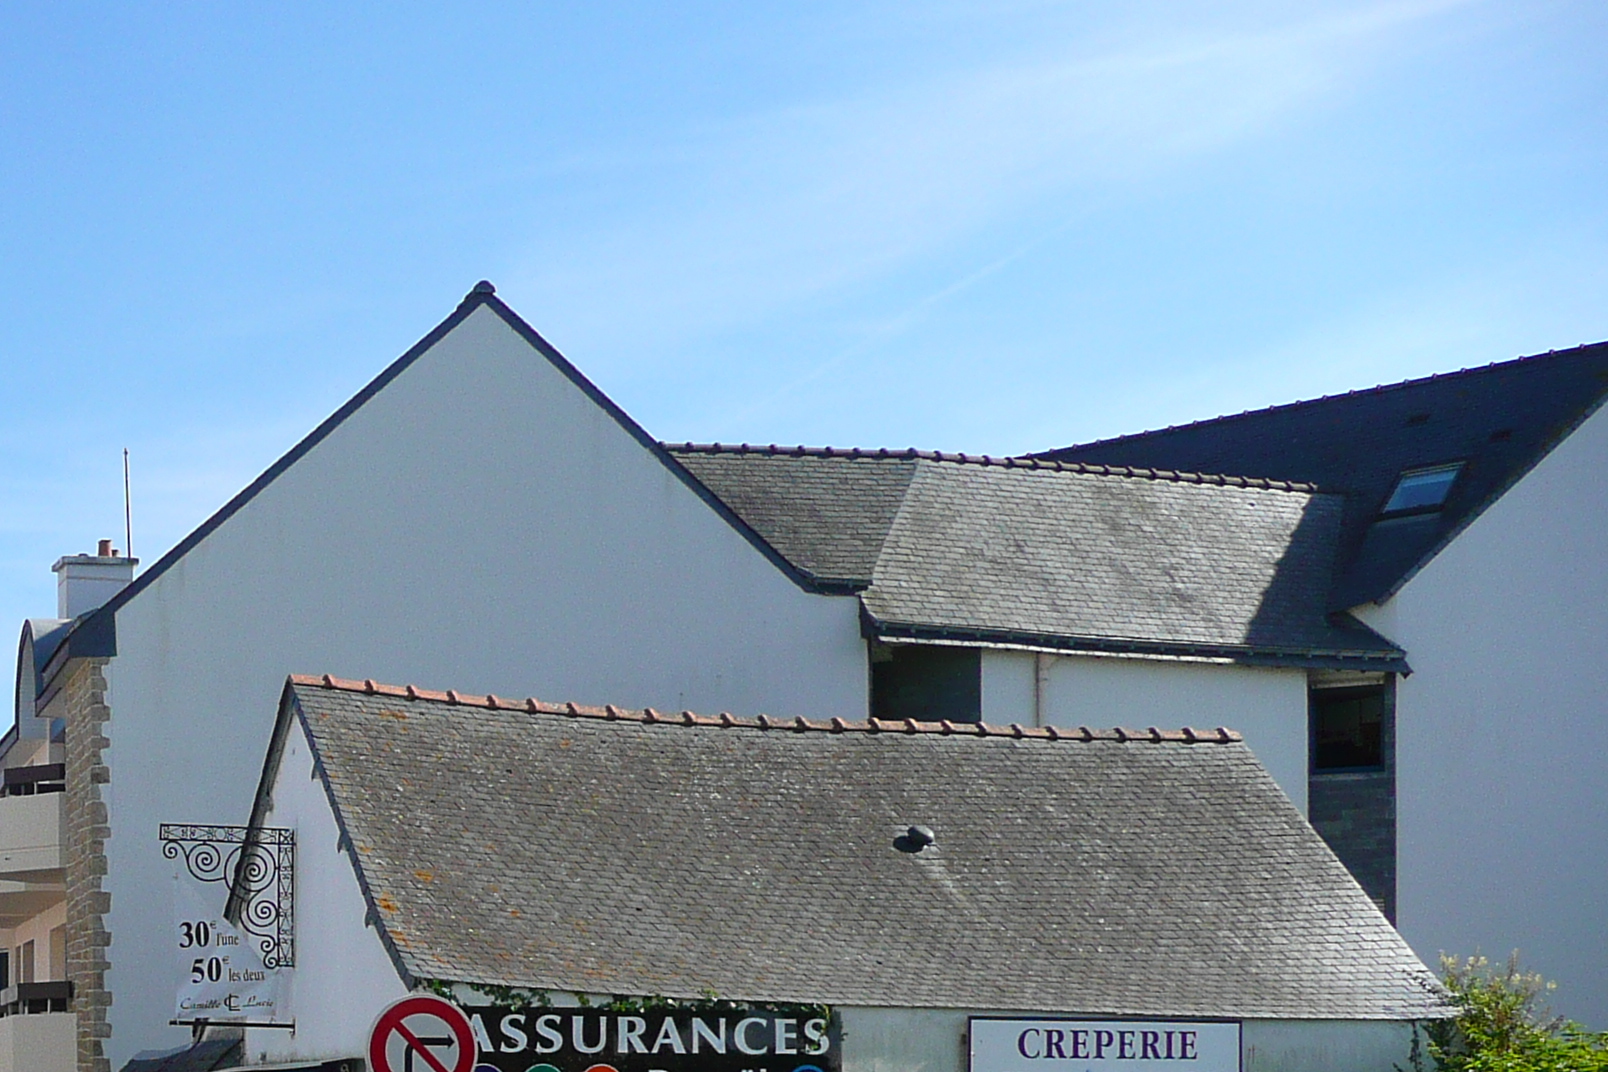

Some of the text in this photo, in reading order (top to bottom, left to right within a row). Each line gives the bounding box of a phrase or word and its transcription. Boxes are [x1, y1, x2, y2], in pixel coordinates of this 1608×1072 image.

[228, 968, 241, 982] les
[243, 968, 265, 982] deux
[469, 1013, 830, 1055] ASSURANCES
[1017, 1028, 1198, 1060] CREPERIE
